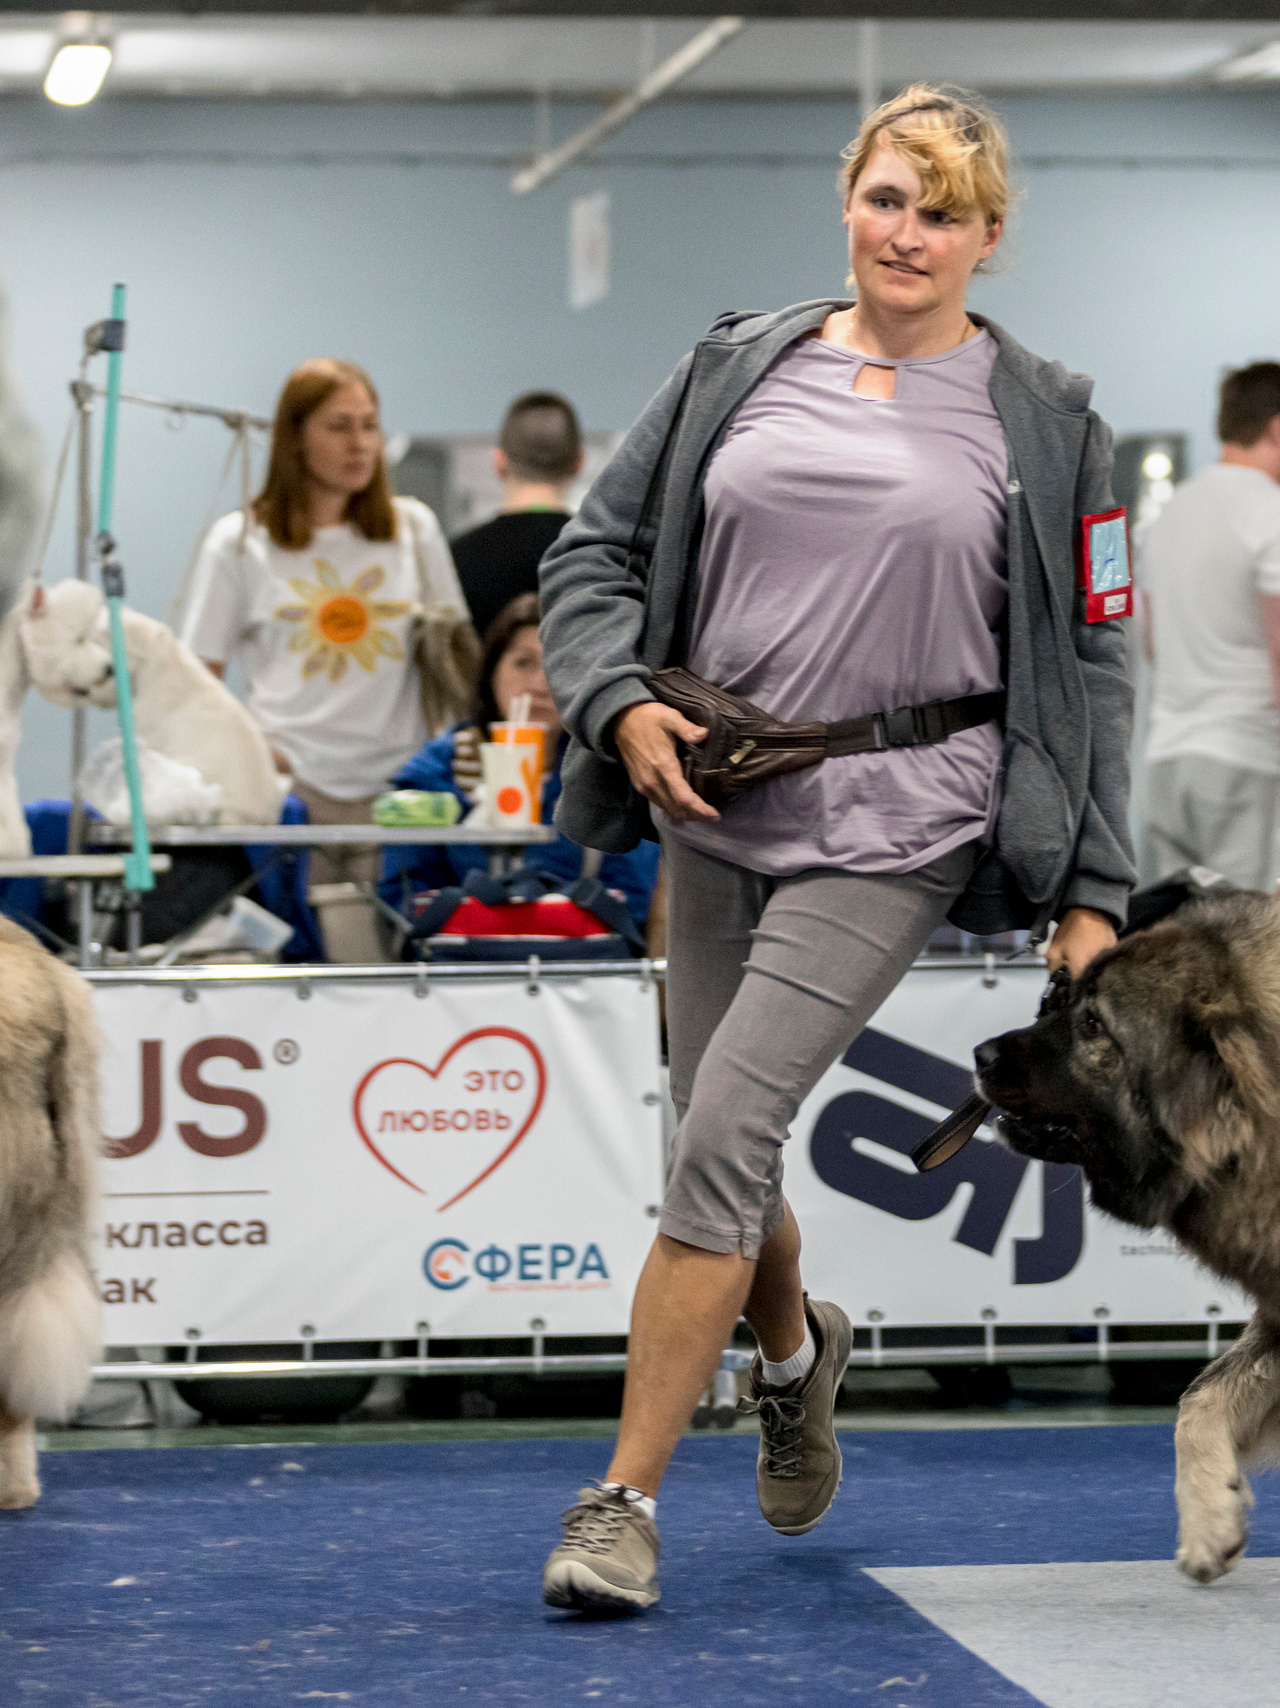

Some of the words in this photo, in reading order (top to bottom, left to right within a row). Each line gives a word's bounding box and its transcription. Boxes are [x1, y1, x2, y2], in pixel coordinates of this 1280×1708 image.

[464, 1069, 524, 1092] ЭТО
[377, 1108, 512, 1133] ЛЮБОВЬ
[421, 1236, 611, 1291] СФЕРА
